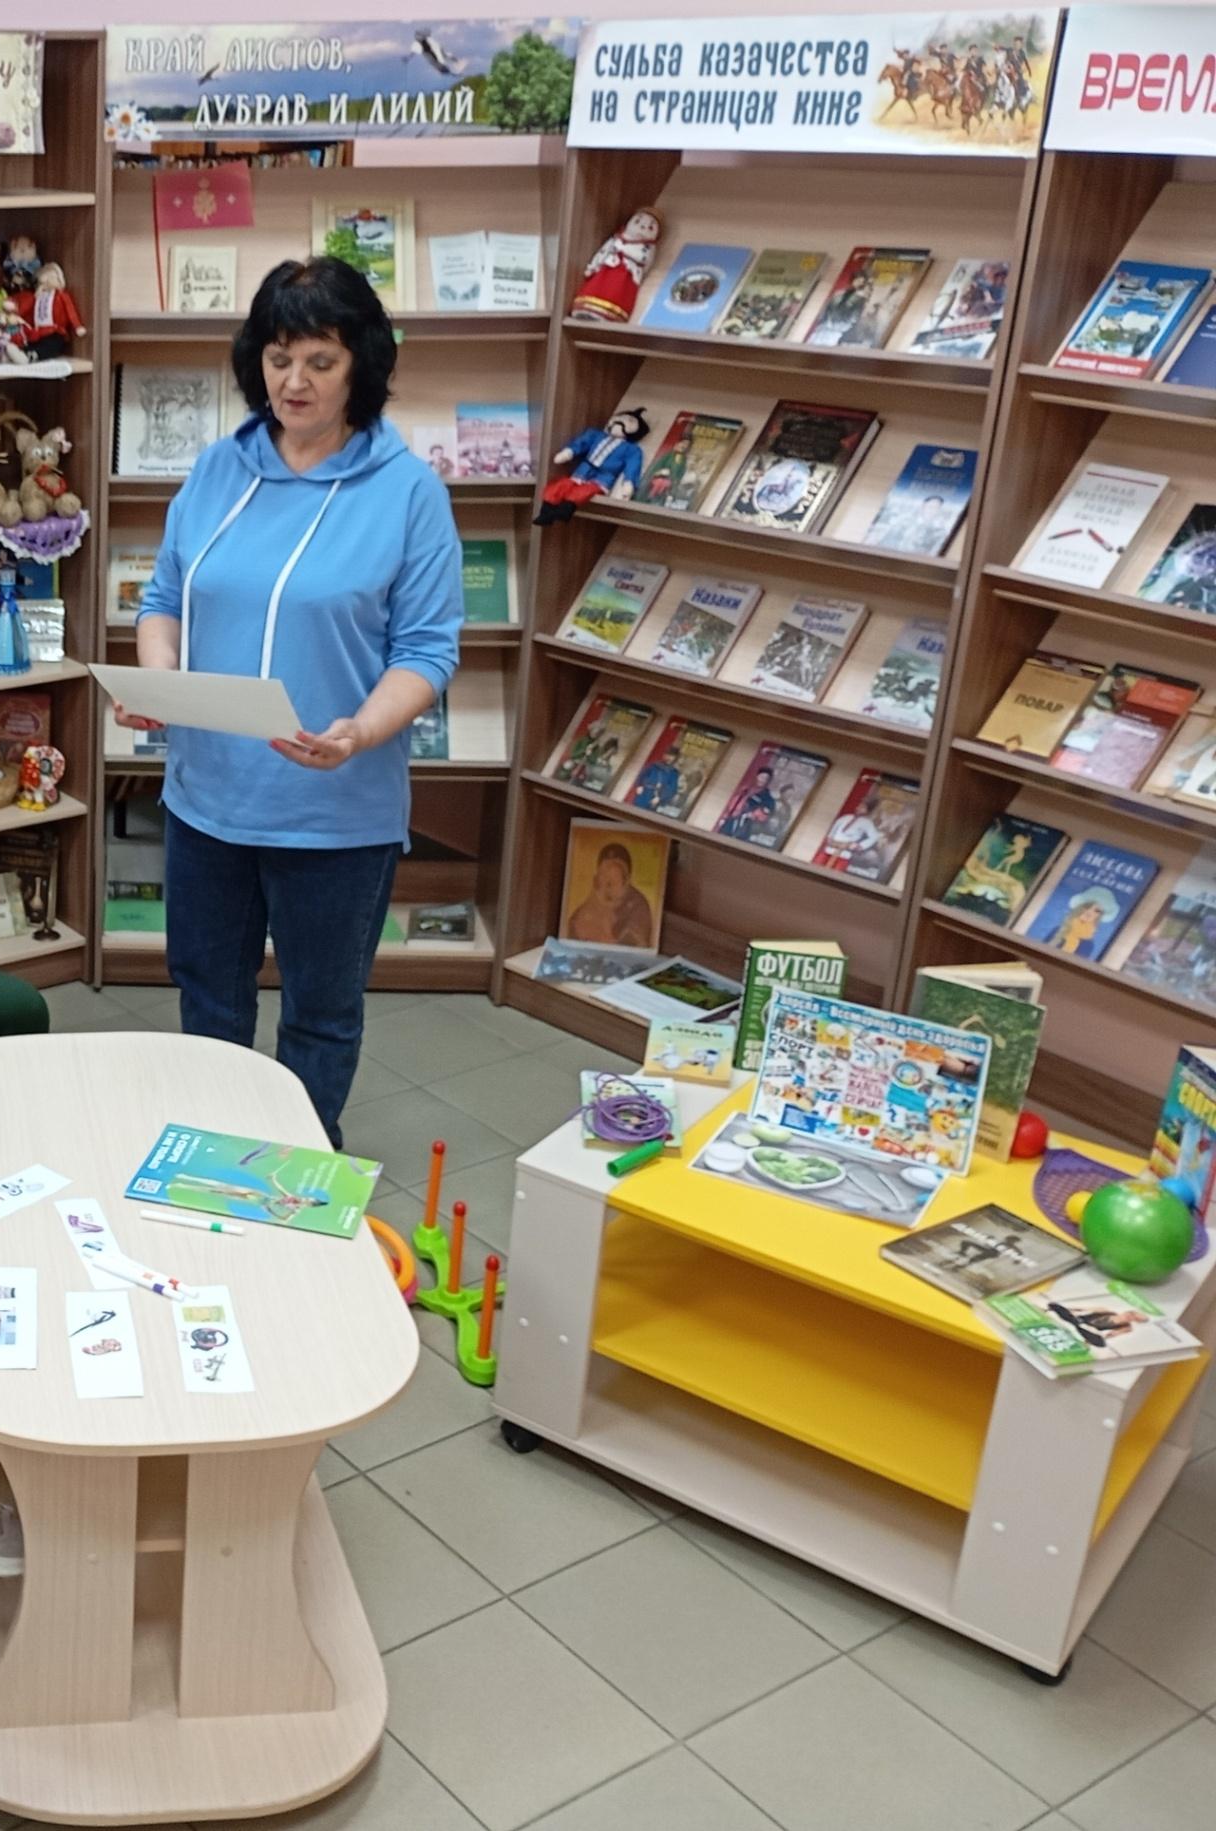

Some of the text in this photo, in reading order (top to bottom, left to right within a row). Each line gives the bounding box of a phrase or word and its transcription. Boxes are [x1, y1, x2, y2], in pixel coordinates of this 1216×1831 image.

[125, 33, 353, 74] КРАЙ АИСТОВ,
[1079, 53, 1216, 114] ВРЕМ
[192, 85, 474, 131] ДУБРАВ И ЛИЛИЙ
[1014, 693, 1065, 713] ПОВАР
[756, 952, 844, 985] ФУТБОЛ
[769, 1032, 814, 1056] СПОРТ
